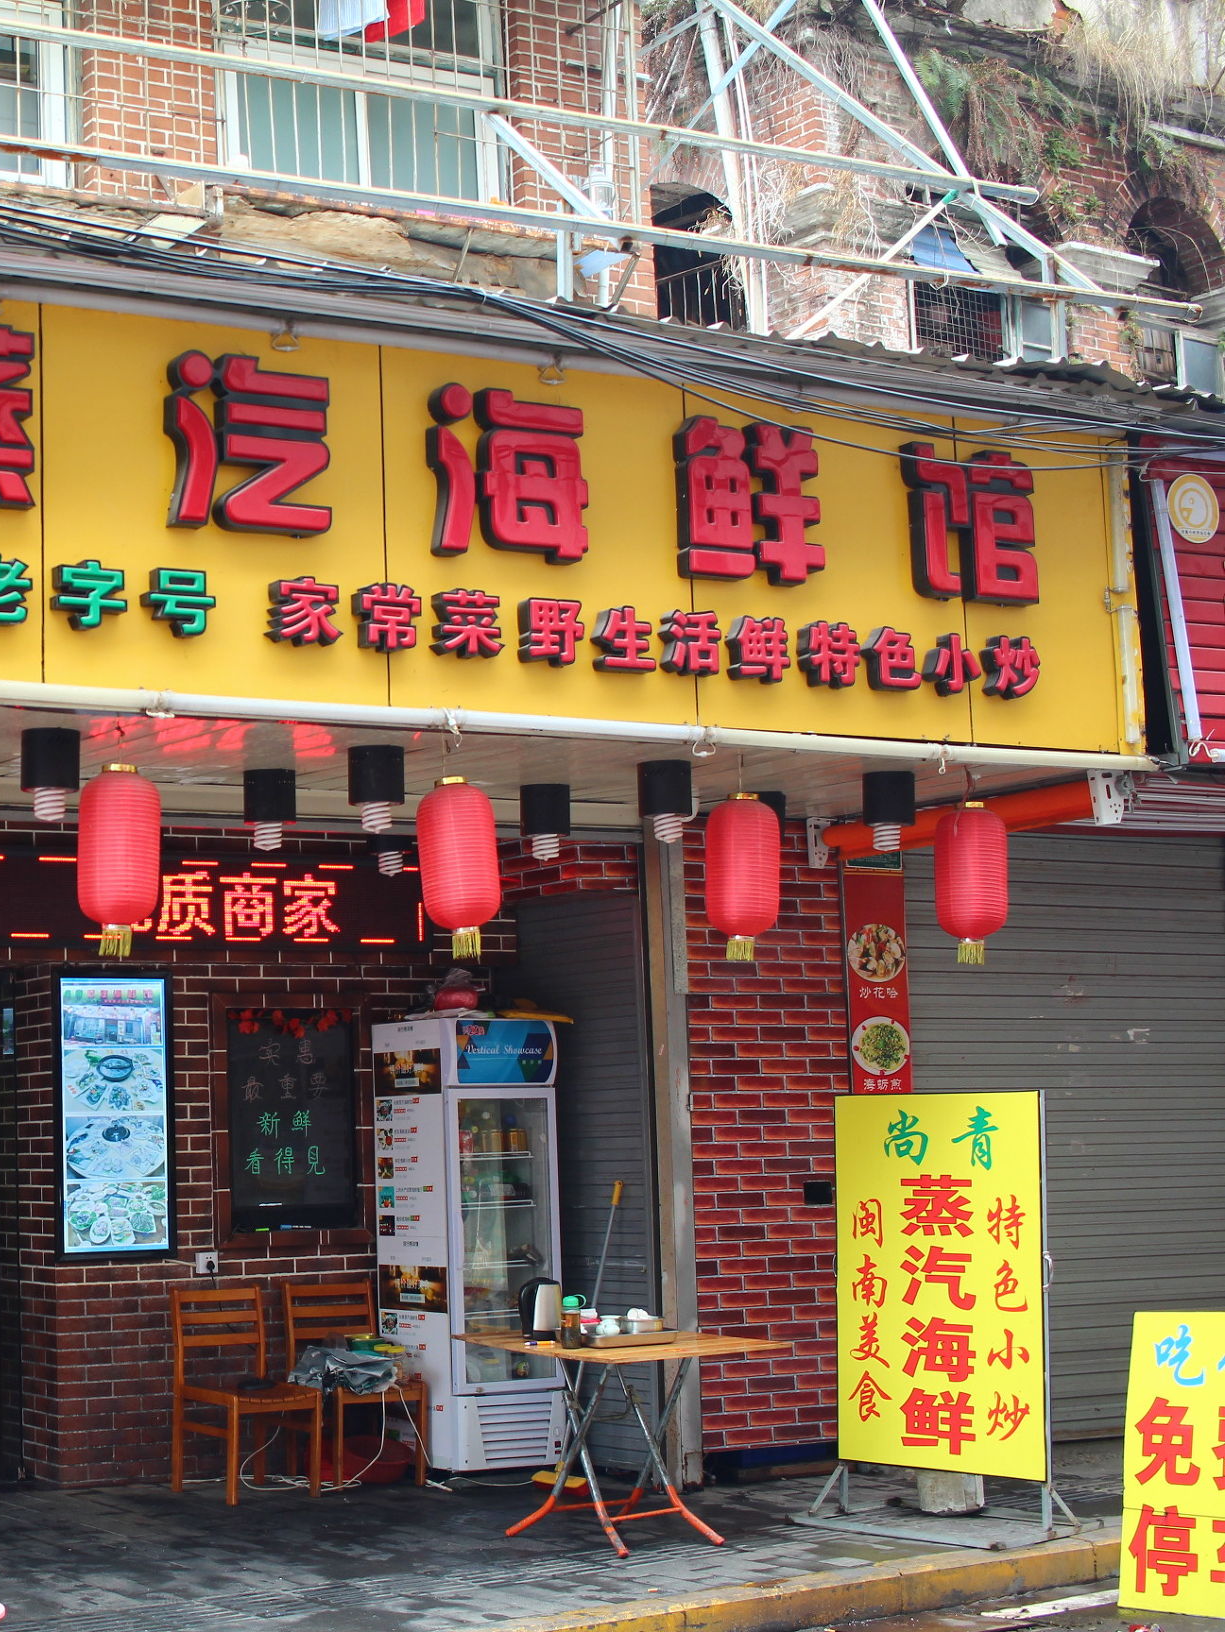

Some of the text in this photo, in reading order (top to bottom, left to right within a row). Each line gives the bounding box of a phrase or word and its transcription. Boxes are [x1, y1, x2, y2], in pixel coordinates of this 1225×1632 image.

[264, 576, 1041, 700] 家常菜野生活鲜特色小炒
[131, 871, 341, 937] 质商家
[465, 1044, 543, 1055] Vertical Showcase
[256, 1110, 313, 1140] 新鲜
[883, 1105, 999, 1171] 尚青
[847, 1198, 892, 1424] 闽南美食
[900, 1174, 977, 1457] 蒸汽海鲜
[986, 1194, 1032, 1442] 特色小炒
[1153, 1323, 1225, 1387] 吃
